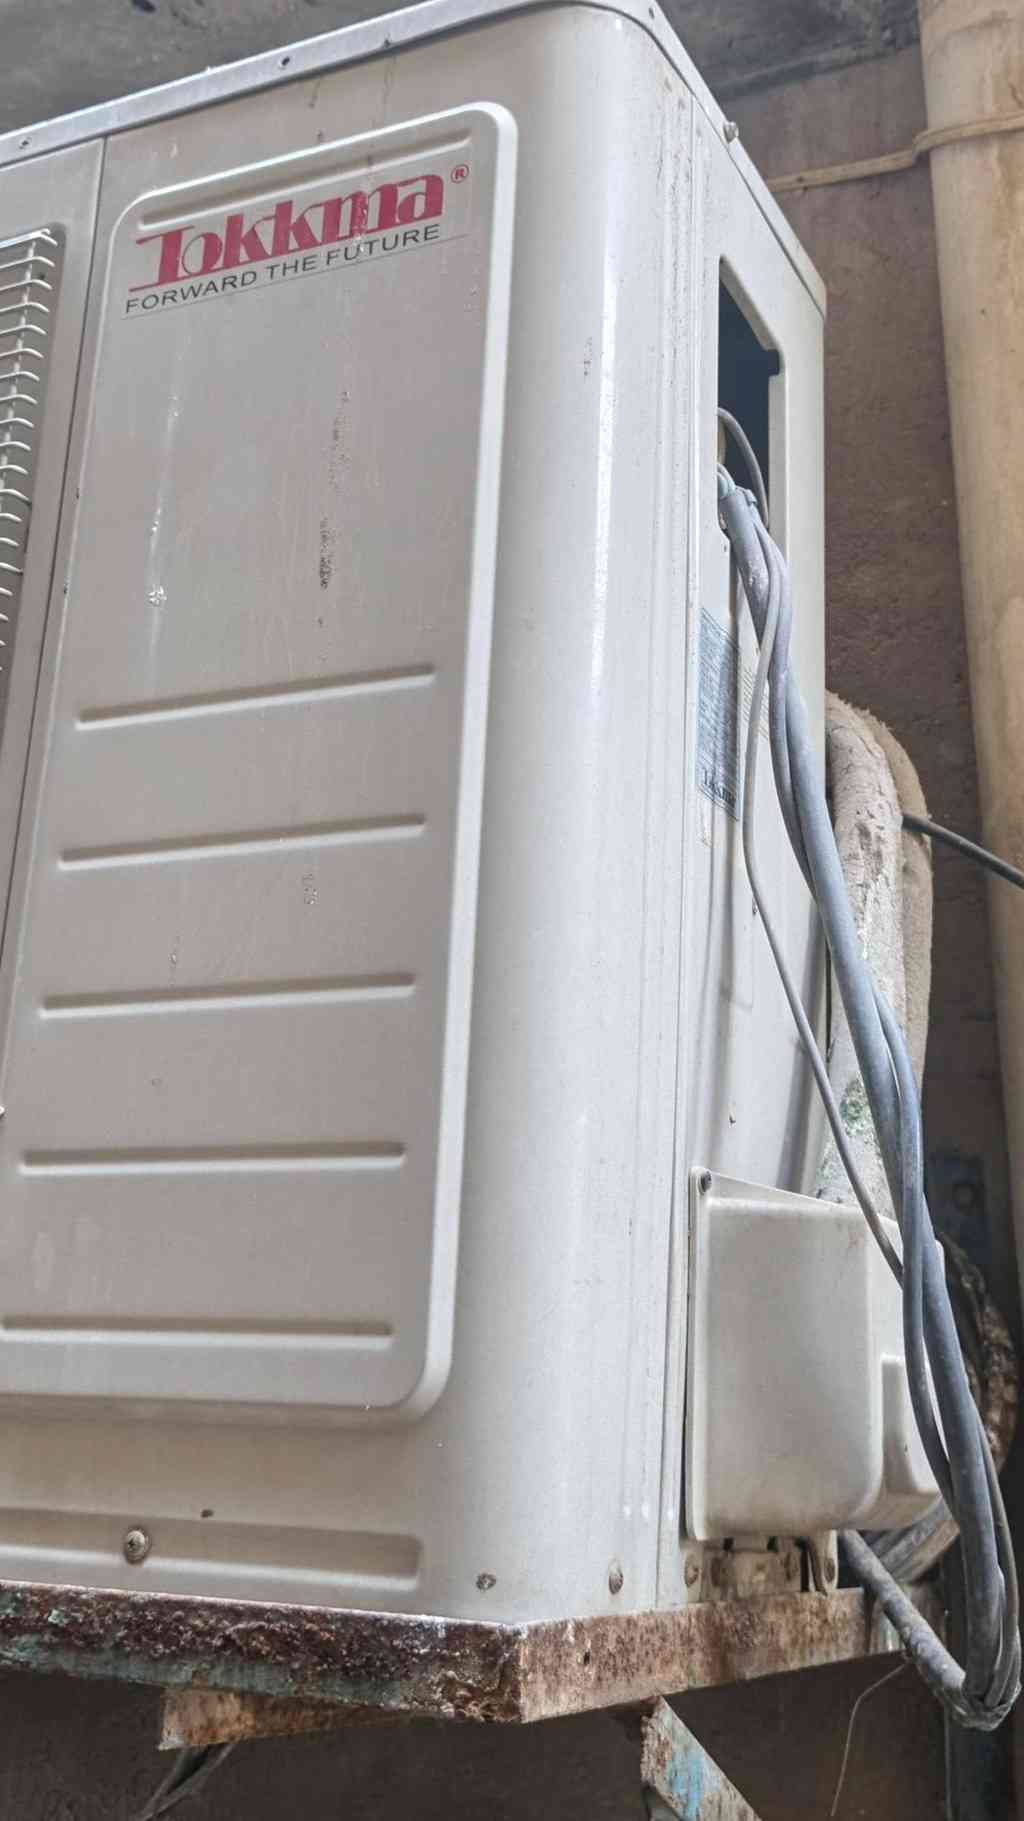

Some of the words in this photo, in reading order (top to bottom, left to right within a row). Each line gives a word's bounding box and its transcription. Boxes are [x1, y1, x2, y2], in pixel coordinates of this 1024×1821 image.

[125, 270, 257, 314] FORWARD
[267, 255, 317, 280] THE
[325, 224, 441, 266] FUTURE
